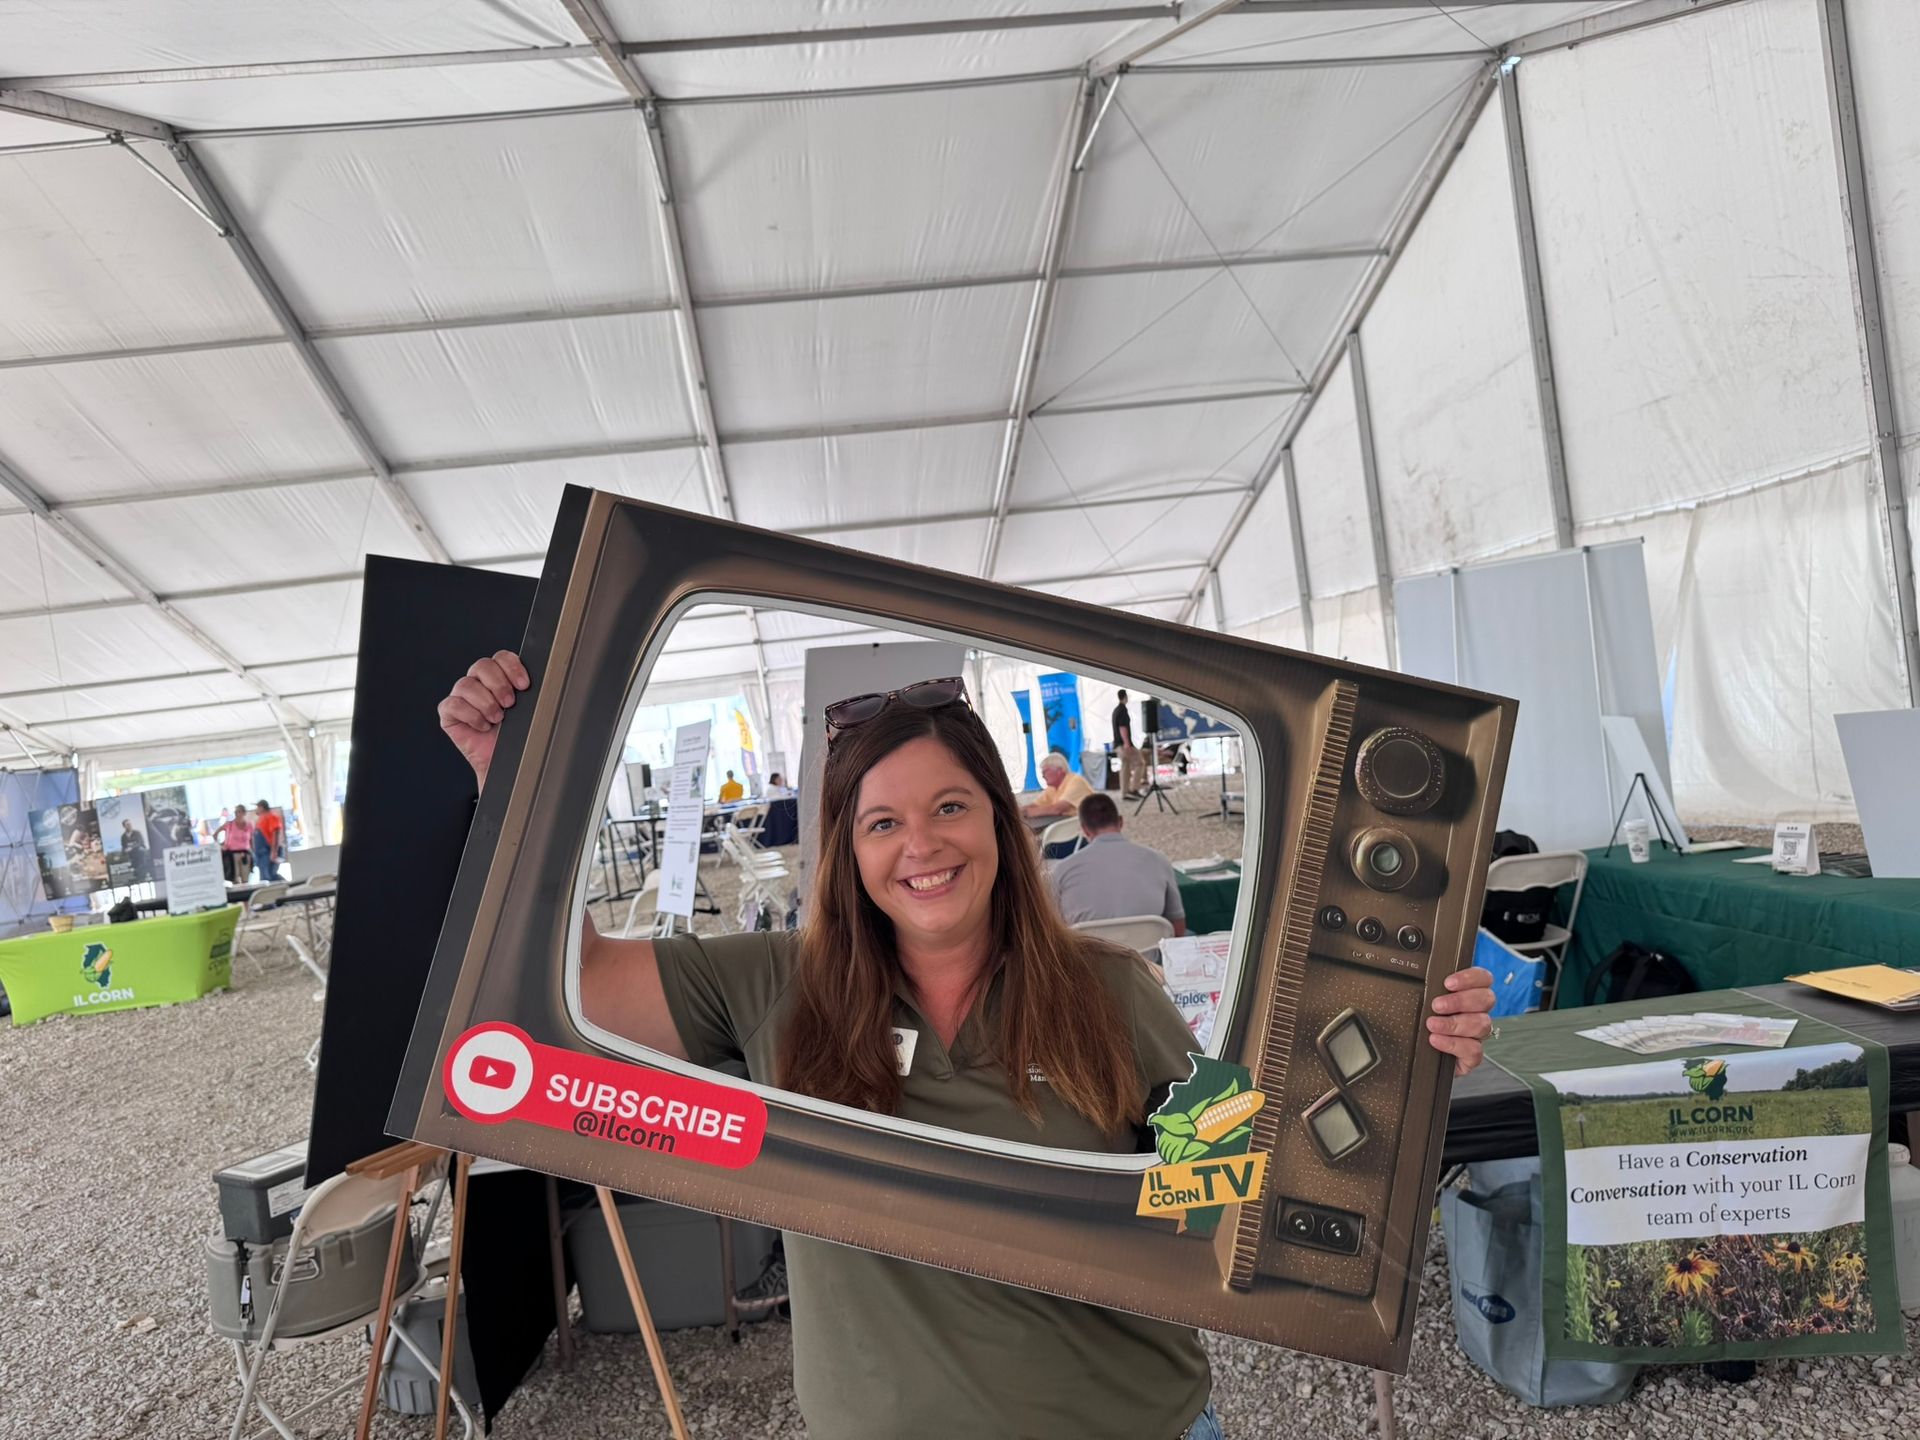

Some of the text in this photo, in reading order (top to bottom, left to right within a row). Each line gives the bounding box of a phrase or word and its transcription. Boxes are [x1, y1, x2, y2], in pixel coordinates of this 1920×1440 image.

[73, 987, 135, 1007] IL CORN
[546, 1073, 746, 1144] SUBSCRIBE
[1669, 1105, 1754, 1125] IL CORN
[573, 1111, 677, 1153] @ilcorn
[1618, 1146, 1808, 1170] Have a Conservation
[1148, 1161, 1254, 1201] IL TV
[1570, 1173, 1856, 1204] Conversation with your IL Corn
[1149, 1188, 1200, 1208] CORN
[1647, 1203, 1791, 1226] team of experts
